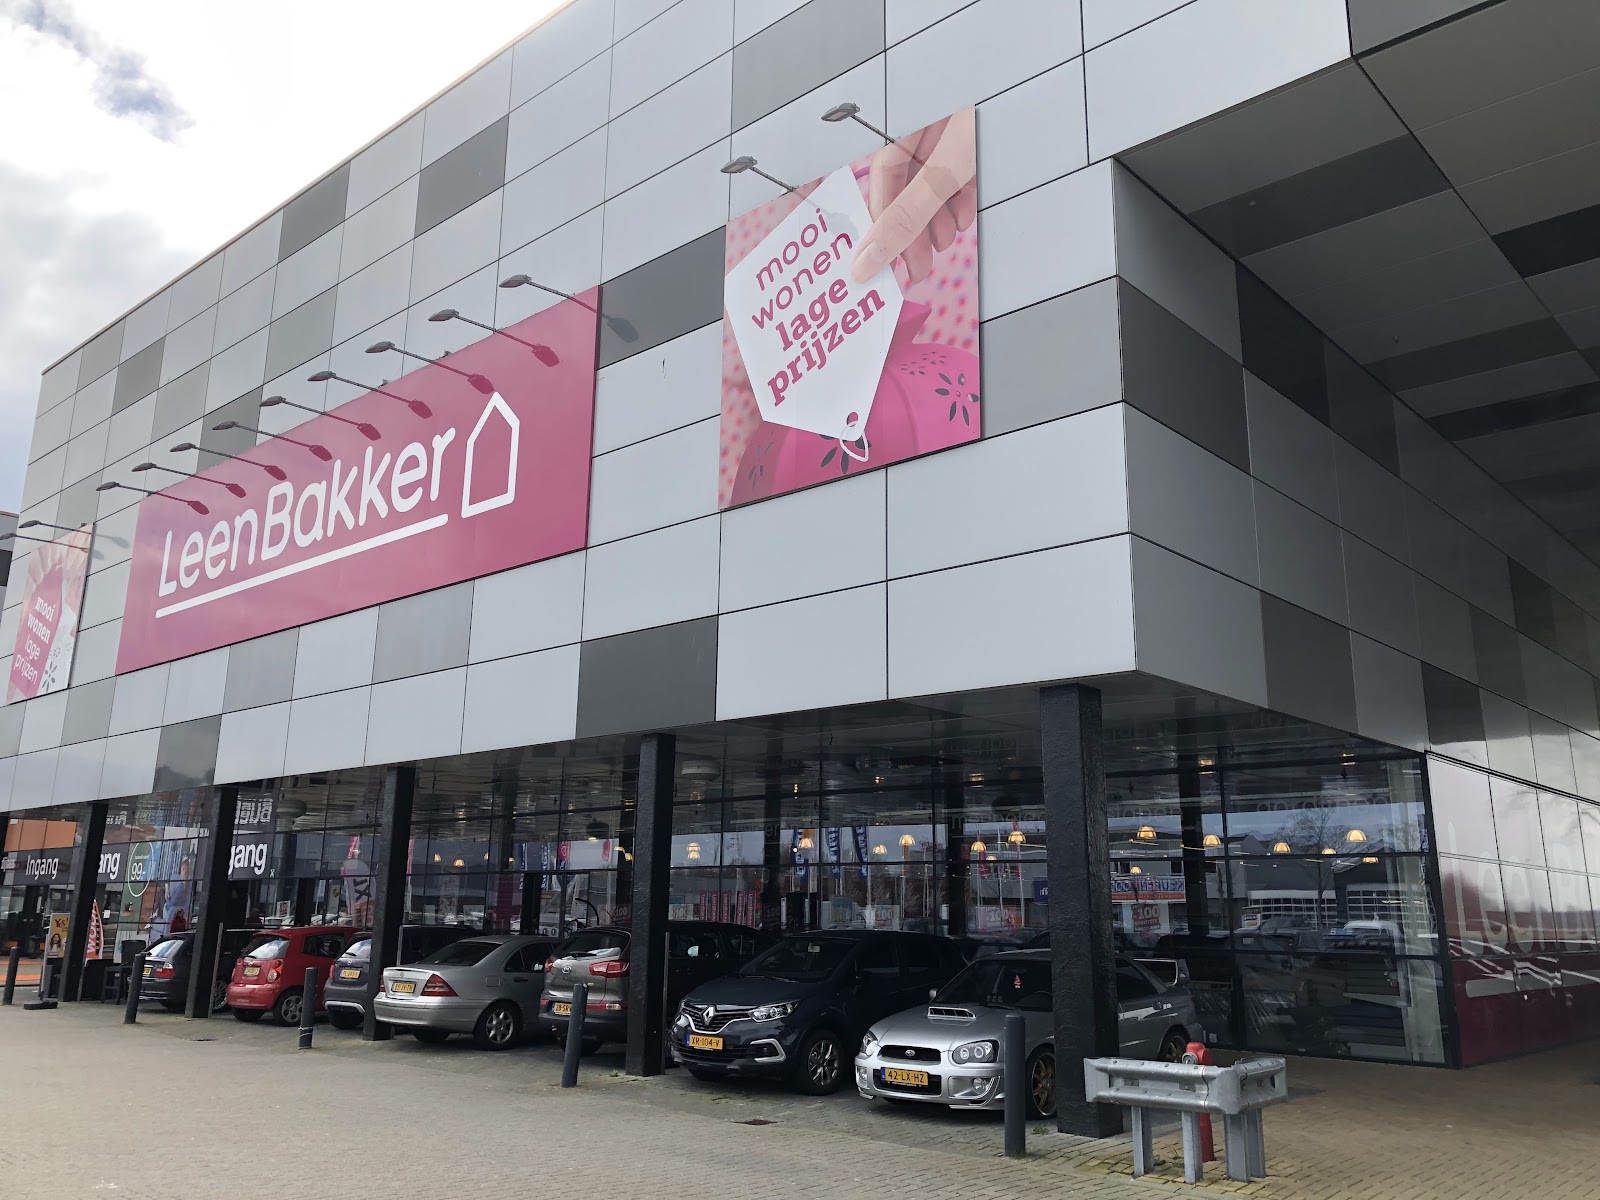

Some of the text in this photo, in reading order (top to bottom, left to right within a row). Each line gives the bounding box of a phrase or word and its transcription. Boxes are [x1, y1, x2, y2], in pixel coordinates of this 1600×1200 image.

[755, 208, 828, 292] mooi
[751, 232, 853, 330] wonen
[775, 278, 849, 351] lage
[767, 289, 885, 407] prijzen
[35, 596, 56, 622] mooi
[27, 612, 51, 645] wonen
[24, 634, 40, 661] lage
[13, 652, 38, 685] prijzen
[25, 854, 59, 880] Ingang
[888, 1070, 925, 1083] 42-LX-HZ
